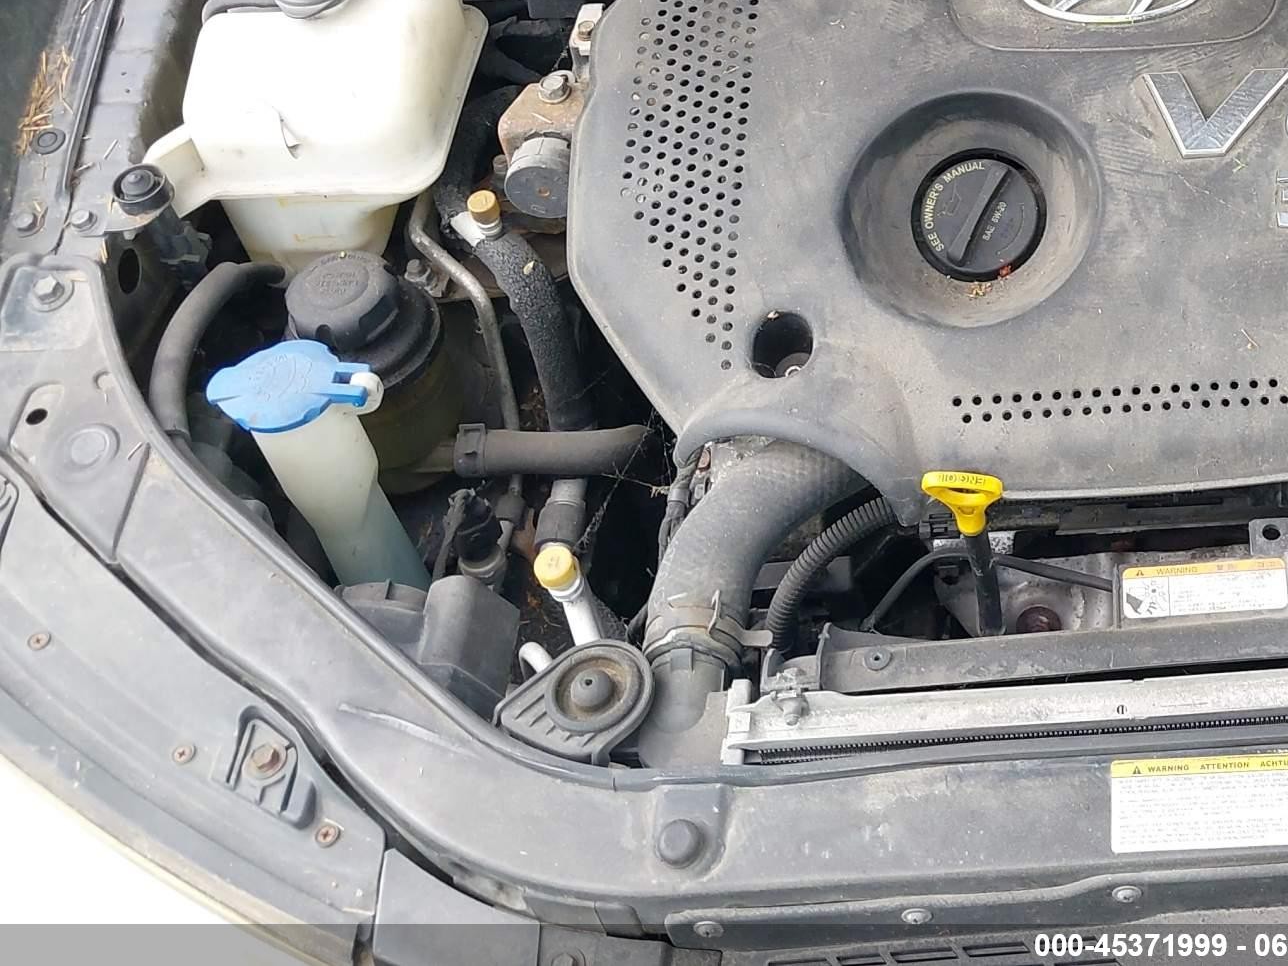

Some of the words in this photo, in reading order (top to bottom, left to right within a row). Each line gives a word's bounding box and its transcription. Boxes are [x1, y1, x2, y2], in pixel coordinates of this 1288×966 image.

[942, 161, 985, 184] MANUAL
[924, 182, 944, 230] OWNER'S
[927, 231, 945, 252] SEE
[1156, 567, 1199, 576] WARNING
[1147, 764, 1190, 773] WARNING
[1200, 762, 1250, 771] ATTENTION
